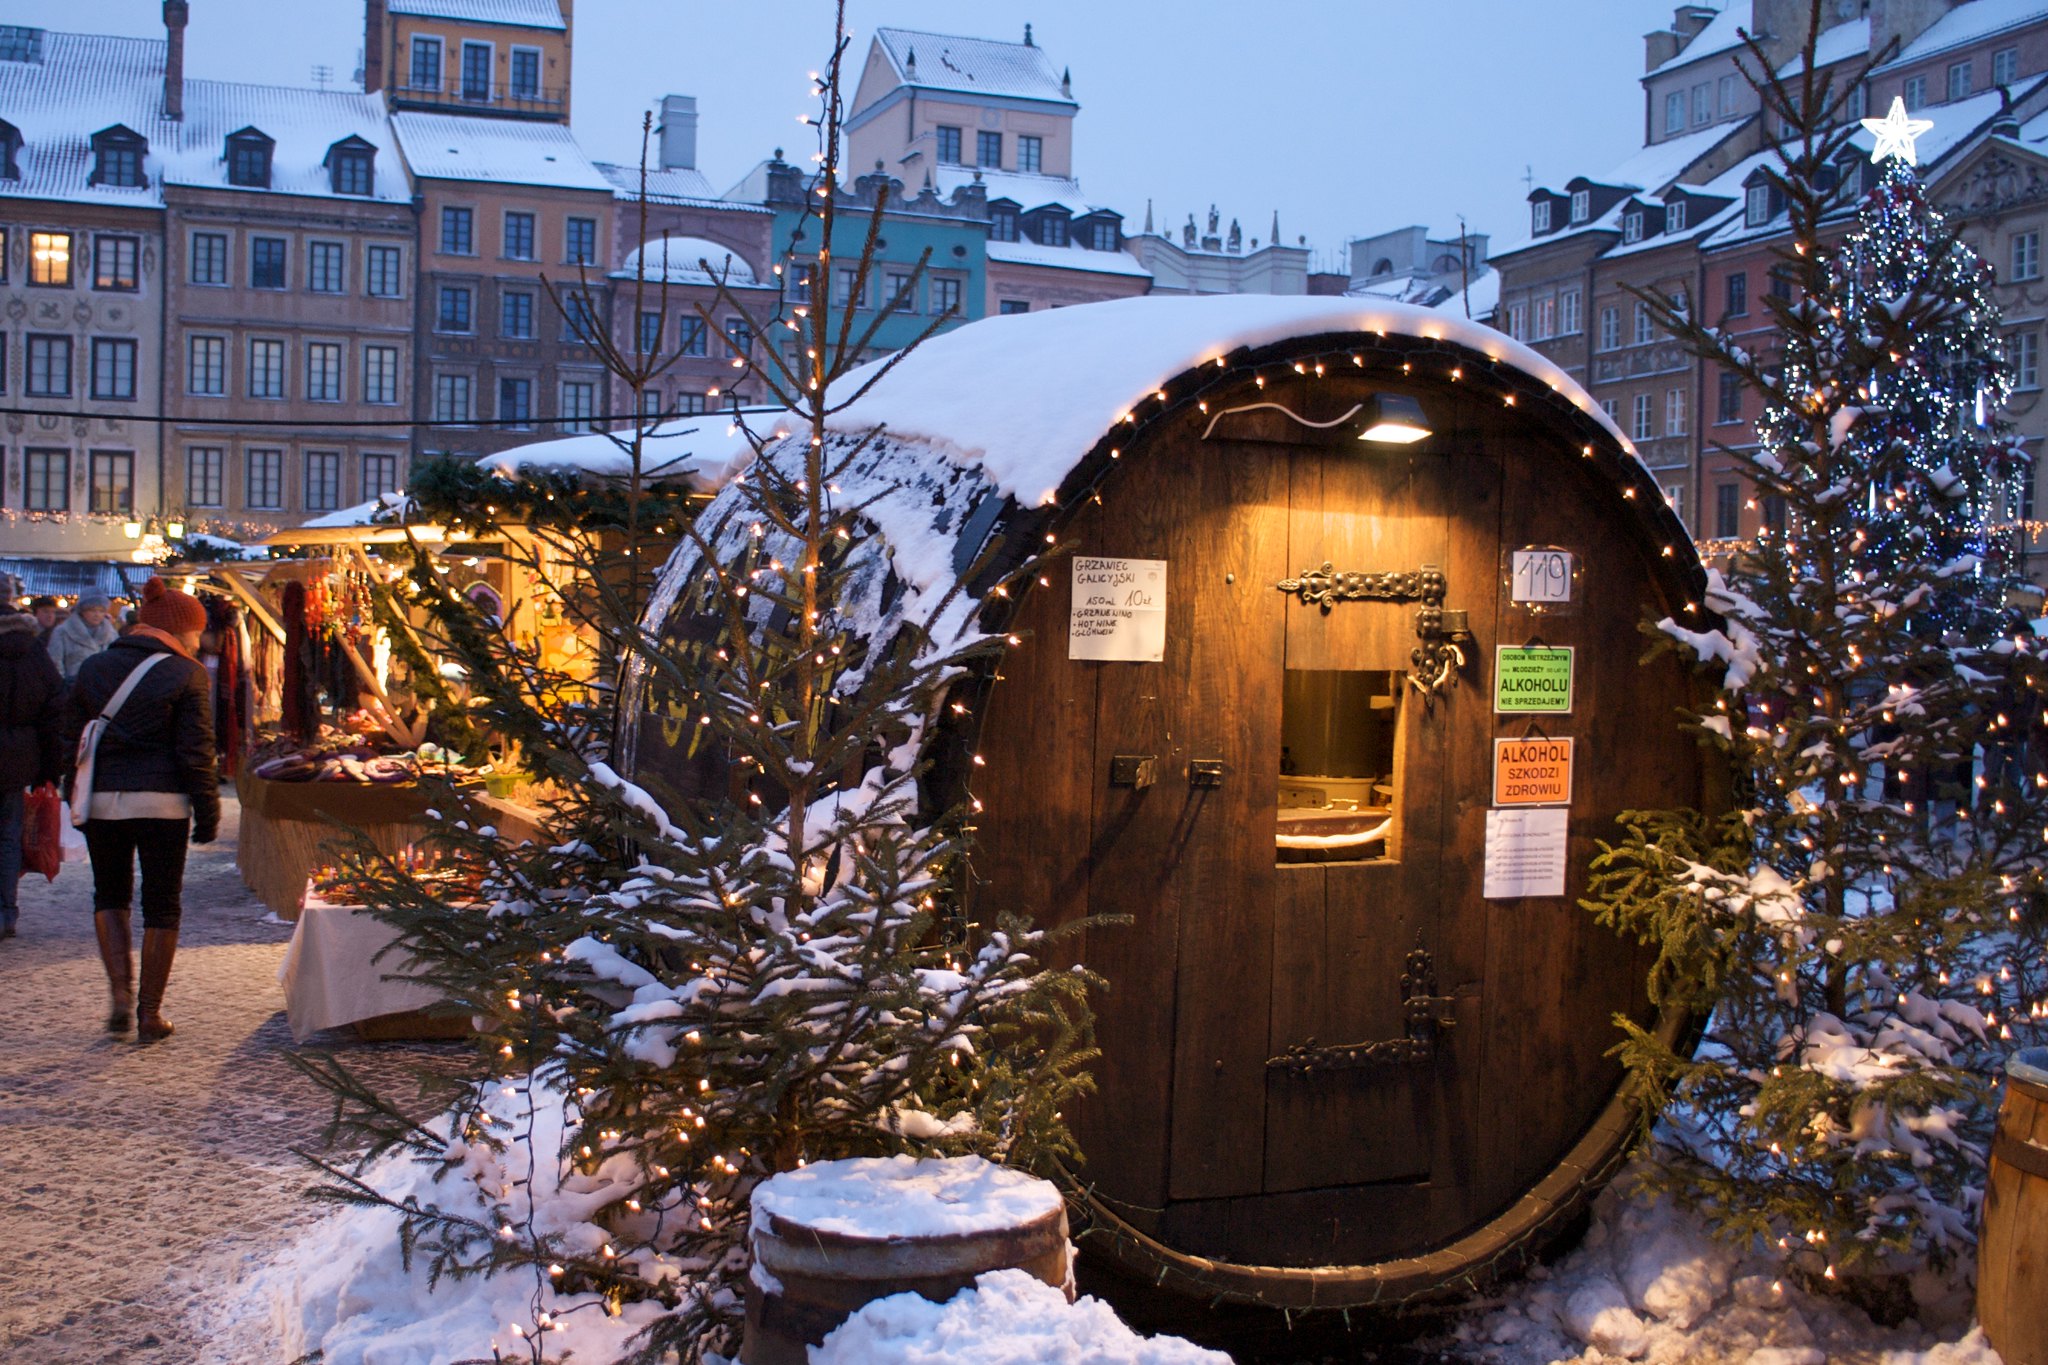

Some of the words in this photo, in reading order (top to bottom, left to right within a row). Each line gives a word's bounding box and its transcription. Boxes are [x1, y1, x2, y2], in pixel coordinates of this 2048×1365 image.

[1075, 560, 1128, 571] GRZANIEC
[1077, 573, 1135, 587] GALICYJSKI
[1518, 553, 1566, 597] 119
[1078, 620, 1095, 628] HOT
[1500, 678, 1568, 692] ALKOHOLU
[1500, 745, 1568, 763] ALKOHOL
[1508, 767, 1560, 780] SZKODZI
[1505, 783, 1561, 796] ZDROWIU
